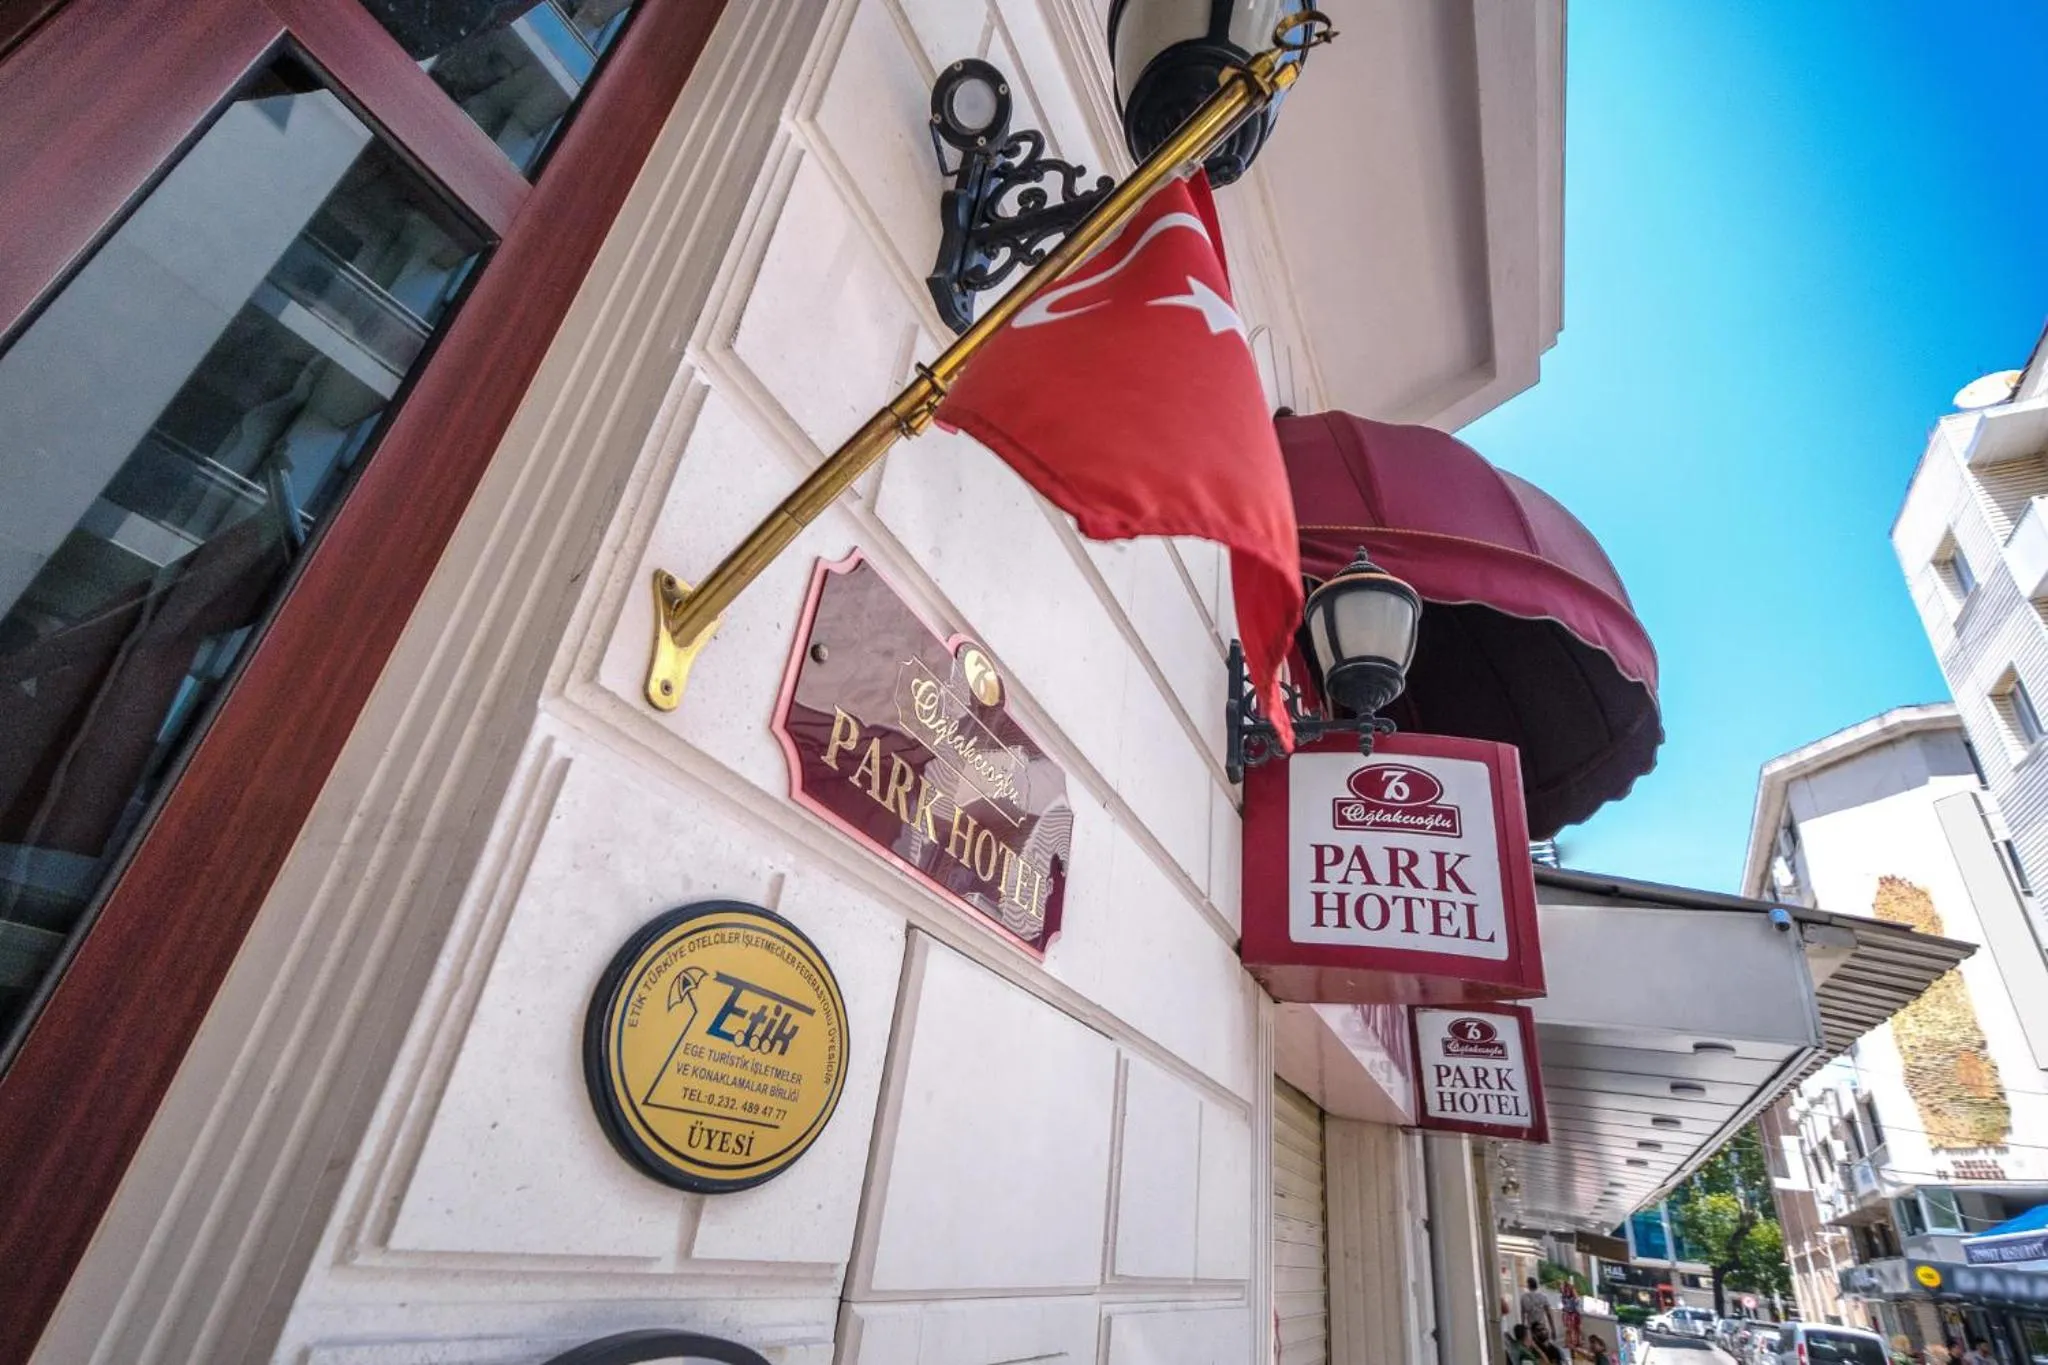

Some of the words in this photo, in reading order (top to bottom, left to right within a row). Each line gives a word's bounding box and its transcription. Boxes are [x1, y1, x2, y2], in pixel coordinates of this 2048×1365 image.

[821, 704, 943, 844] PARK
[945, 803, 1043, 920] HOTEL
[1310, 843, 1477, 896] PARK
[1310, 890, 1495, 943] HOTEL
[628, 993, 647, 1028] ETİK
[643, 946, 687, 992] TÜRKİYE
[677, 1061, 691, 1076] VE
[692, 1065, 768, 1097] KONAKLAMALAR
[683, 1043, 705, 1059] EGE
[708, 1049, 750, 1071] TURİSTİK
[751, 1058, 803, 1084] İŞLETMELER
[1433, 1064, 1517, 1091] PARK
[742, 1100, 760, 1115] 489
[761, 1104, 774, 1118] 47
[775, 1108, 788, 1121] 77
[1436, 1091, 1528, 1118] HOTEL
[687, 1120, 756, 1157] ÜYESİ
